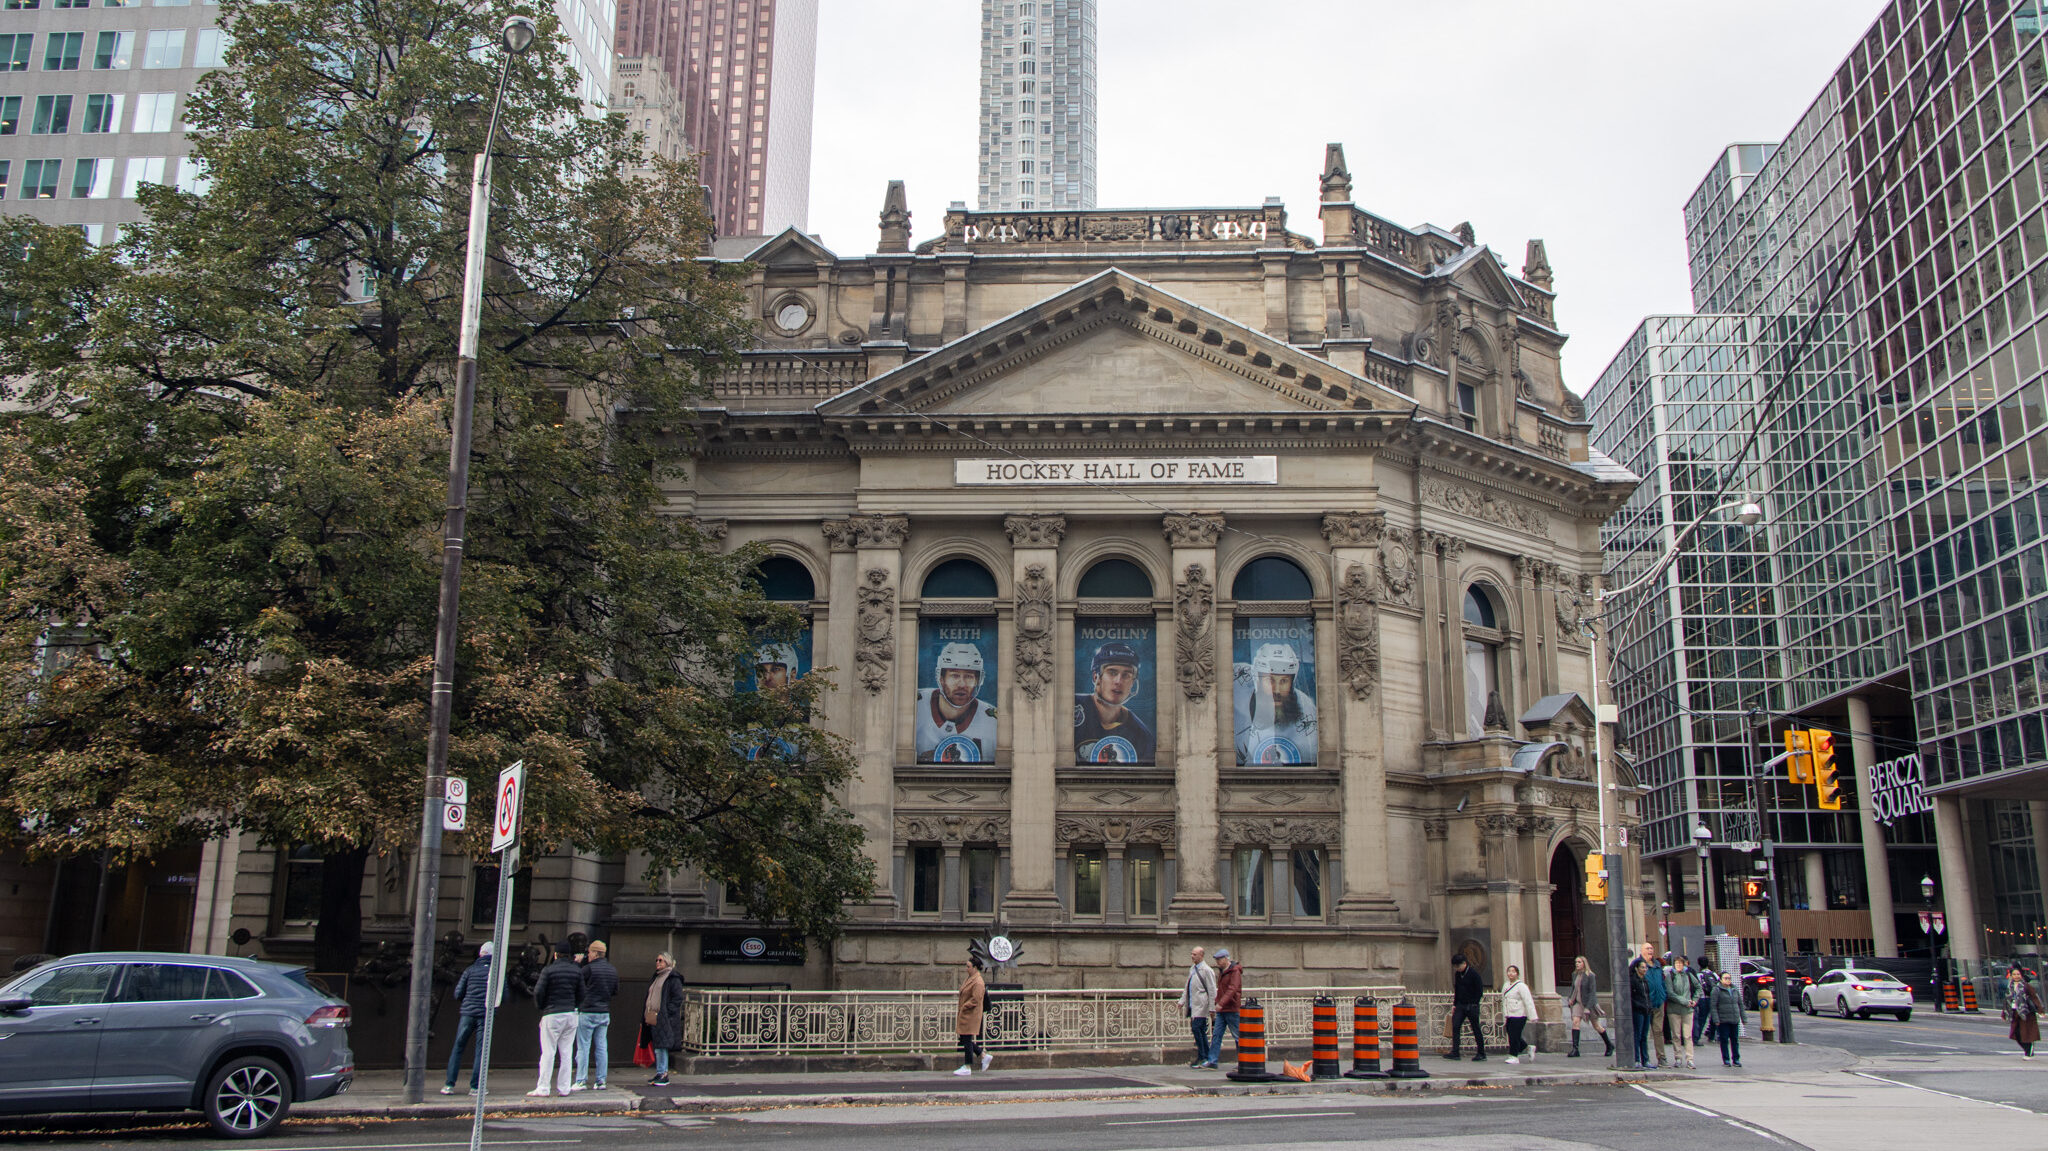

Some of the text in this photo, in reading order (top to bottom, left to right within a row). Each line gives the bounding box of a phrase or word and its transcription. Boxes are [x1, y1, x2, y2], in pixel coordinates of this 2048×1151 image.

[986, 462, 1245, 480] HOCKEY HALL OF FAME
[939, 627, 982, 640] KEITH
[1080, 627, 1149, 641] MOGILNY
[1235, 627, 1311, 640] THORNTON
[1867, 752, 1922, 793] BERCZY
[745, 942, 762, 950] Esso
